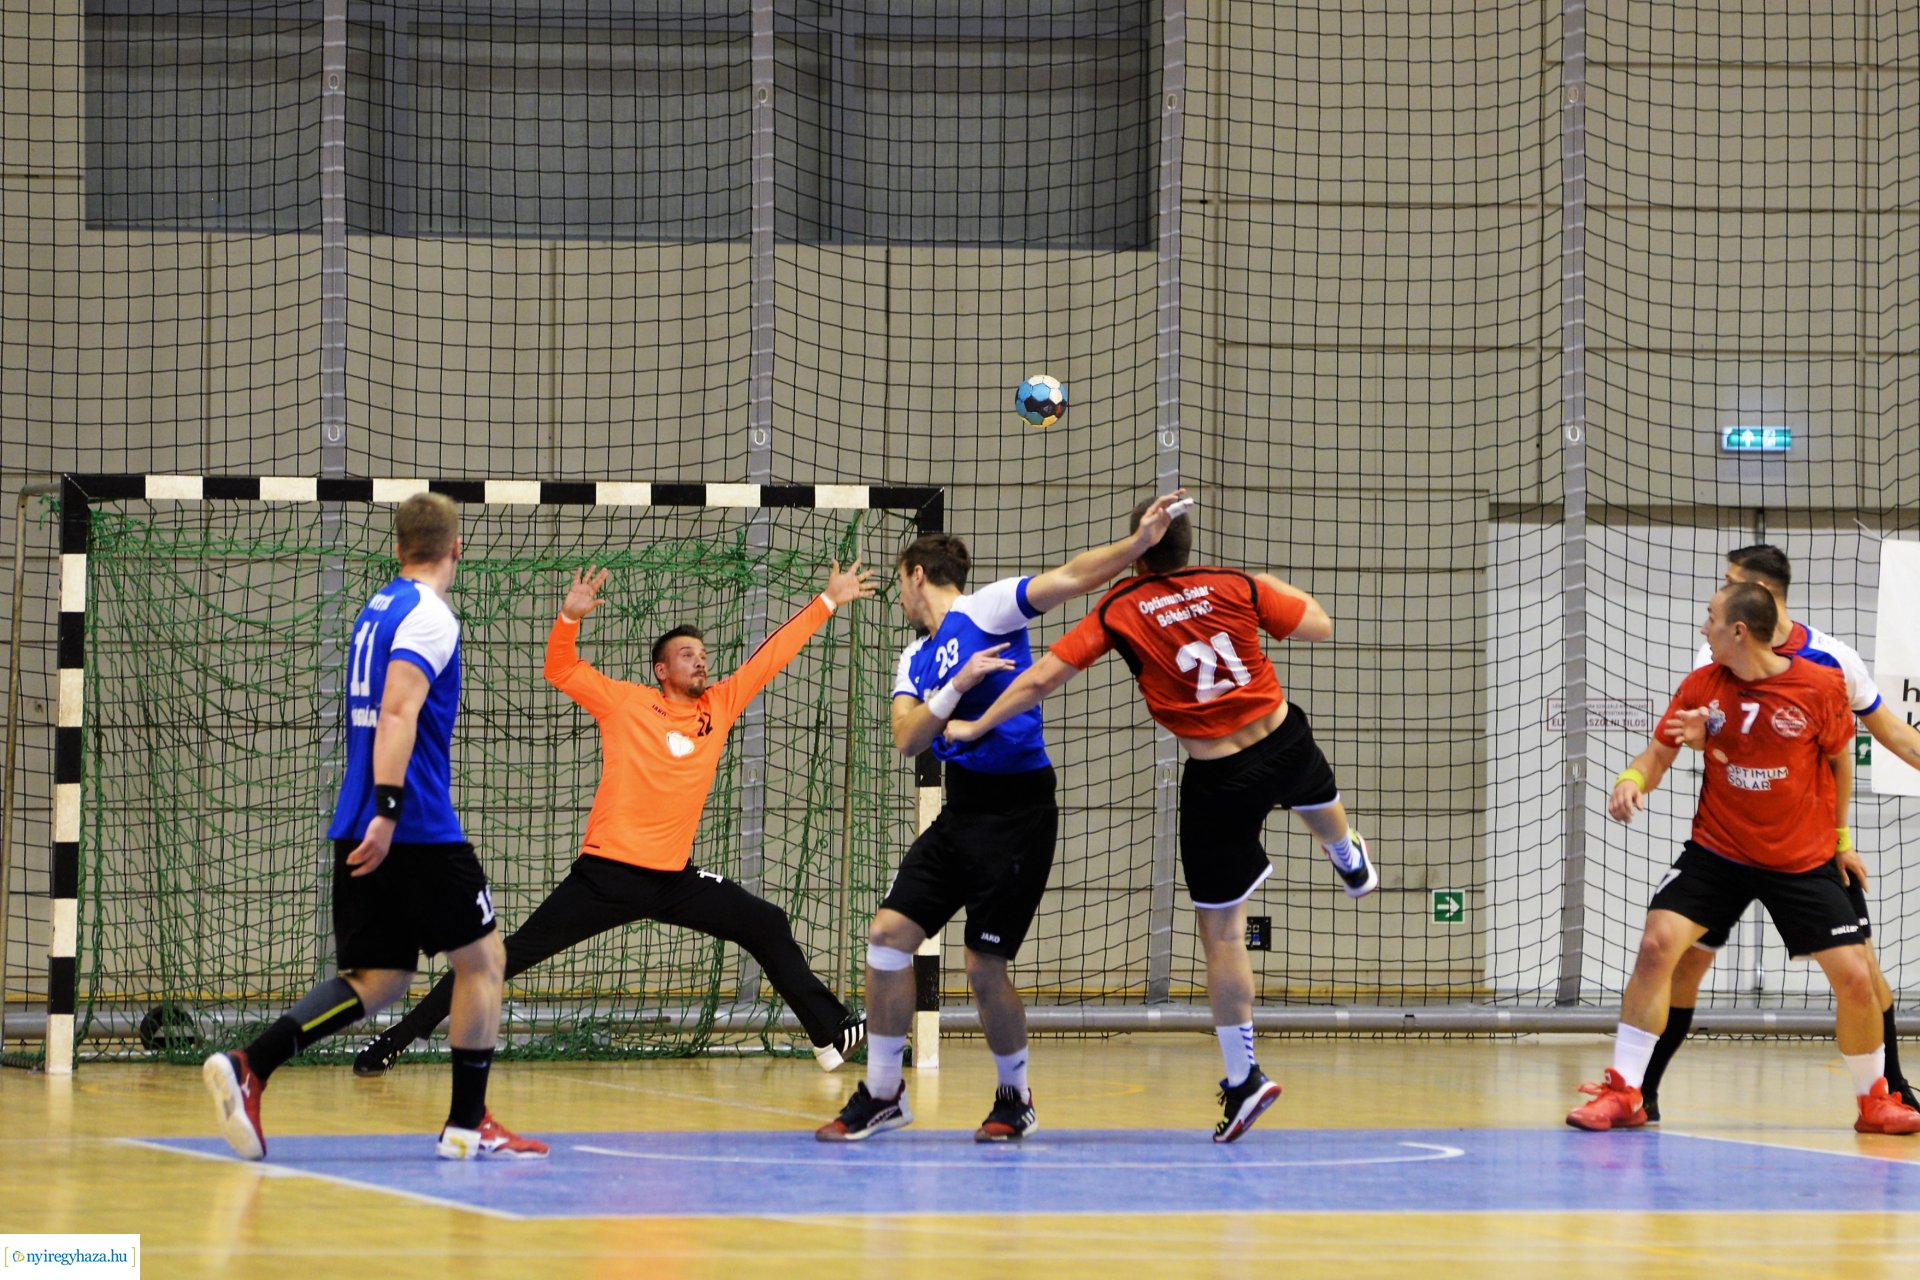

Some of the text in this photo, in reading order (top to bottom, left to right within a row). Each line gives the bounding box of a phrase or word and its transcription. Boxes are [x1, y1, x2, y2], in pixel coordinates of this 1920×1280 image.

[1138, 595, 1185, 615] Optimum
[1189, 600, 1213, 618] FKC
[350, 620, 379, 697] 11
[935, 637, 959, 680] 23
[1176, 631, 1252, 703] 21
[1740, 702, 1760, 735] 7
[1727, 764, 1788, 779] OPTIMUM
[1728, 774, 1772, 790] SOLAR
